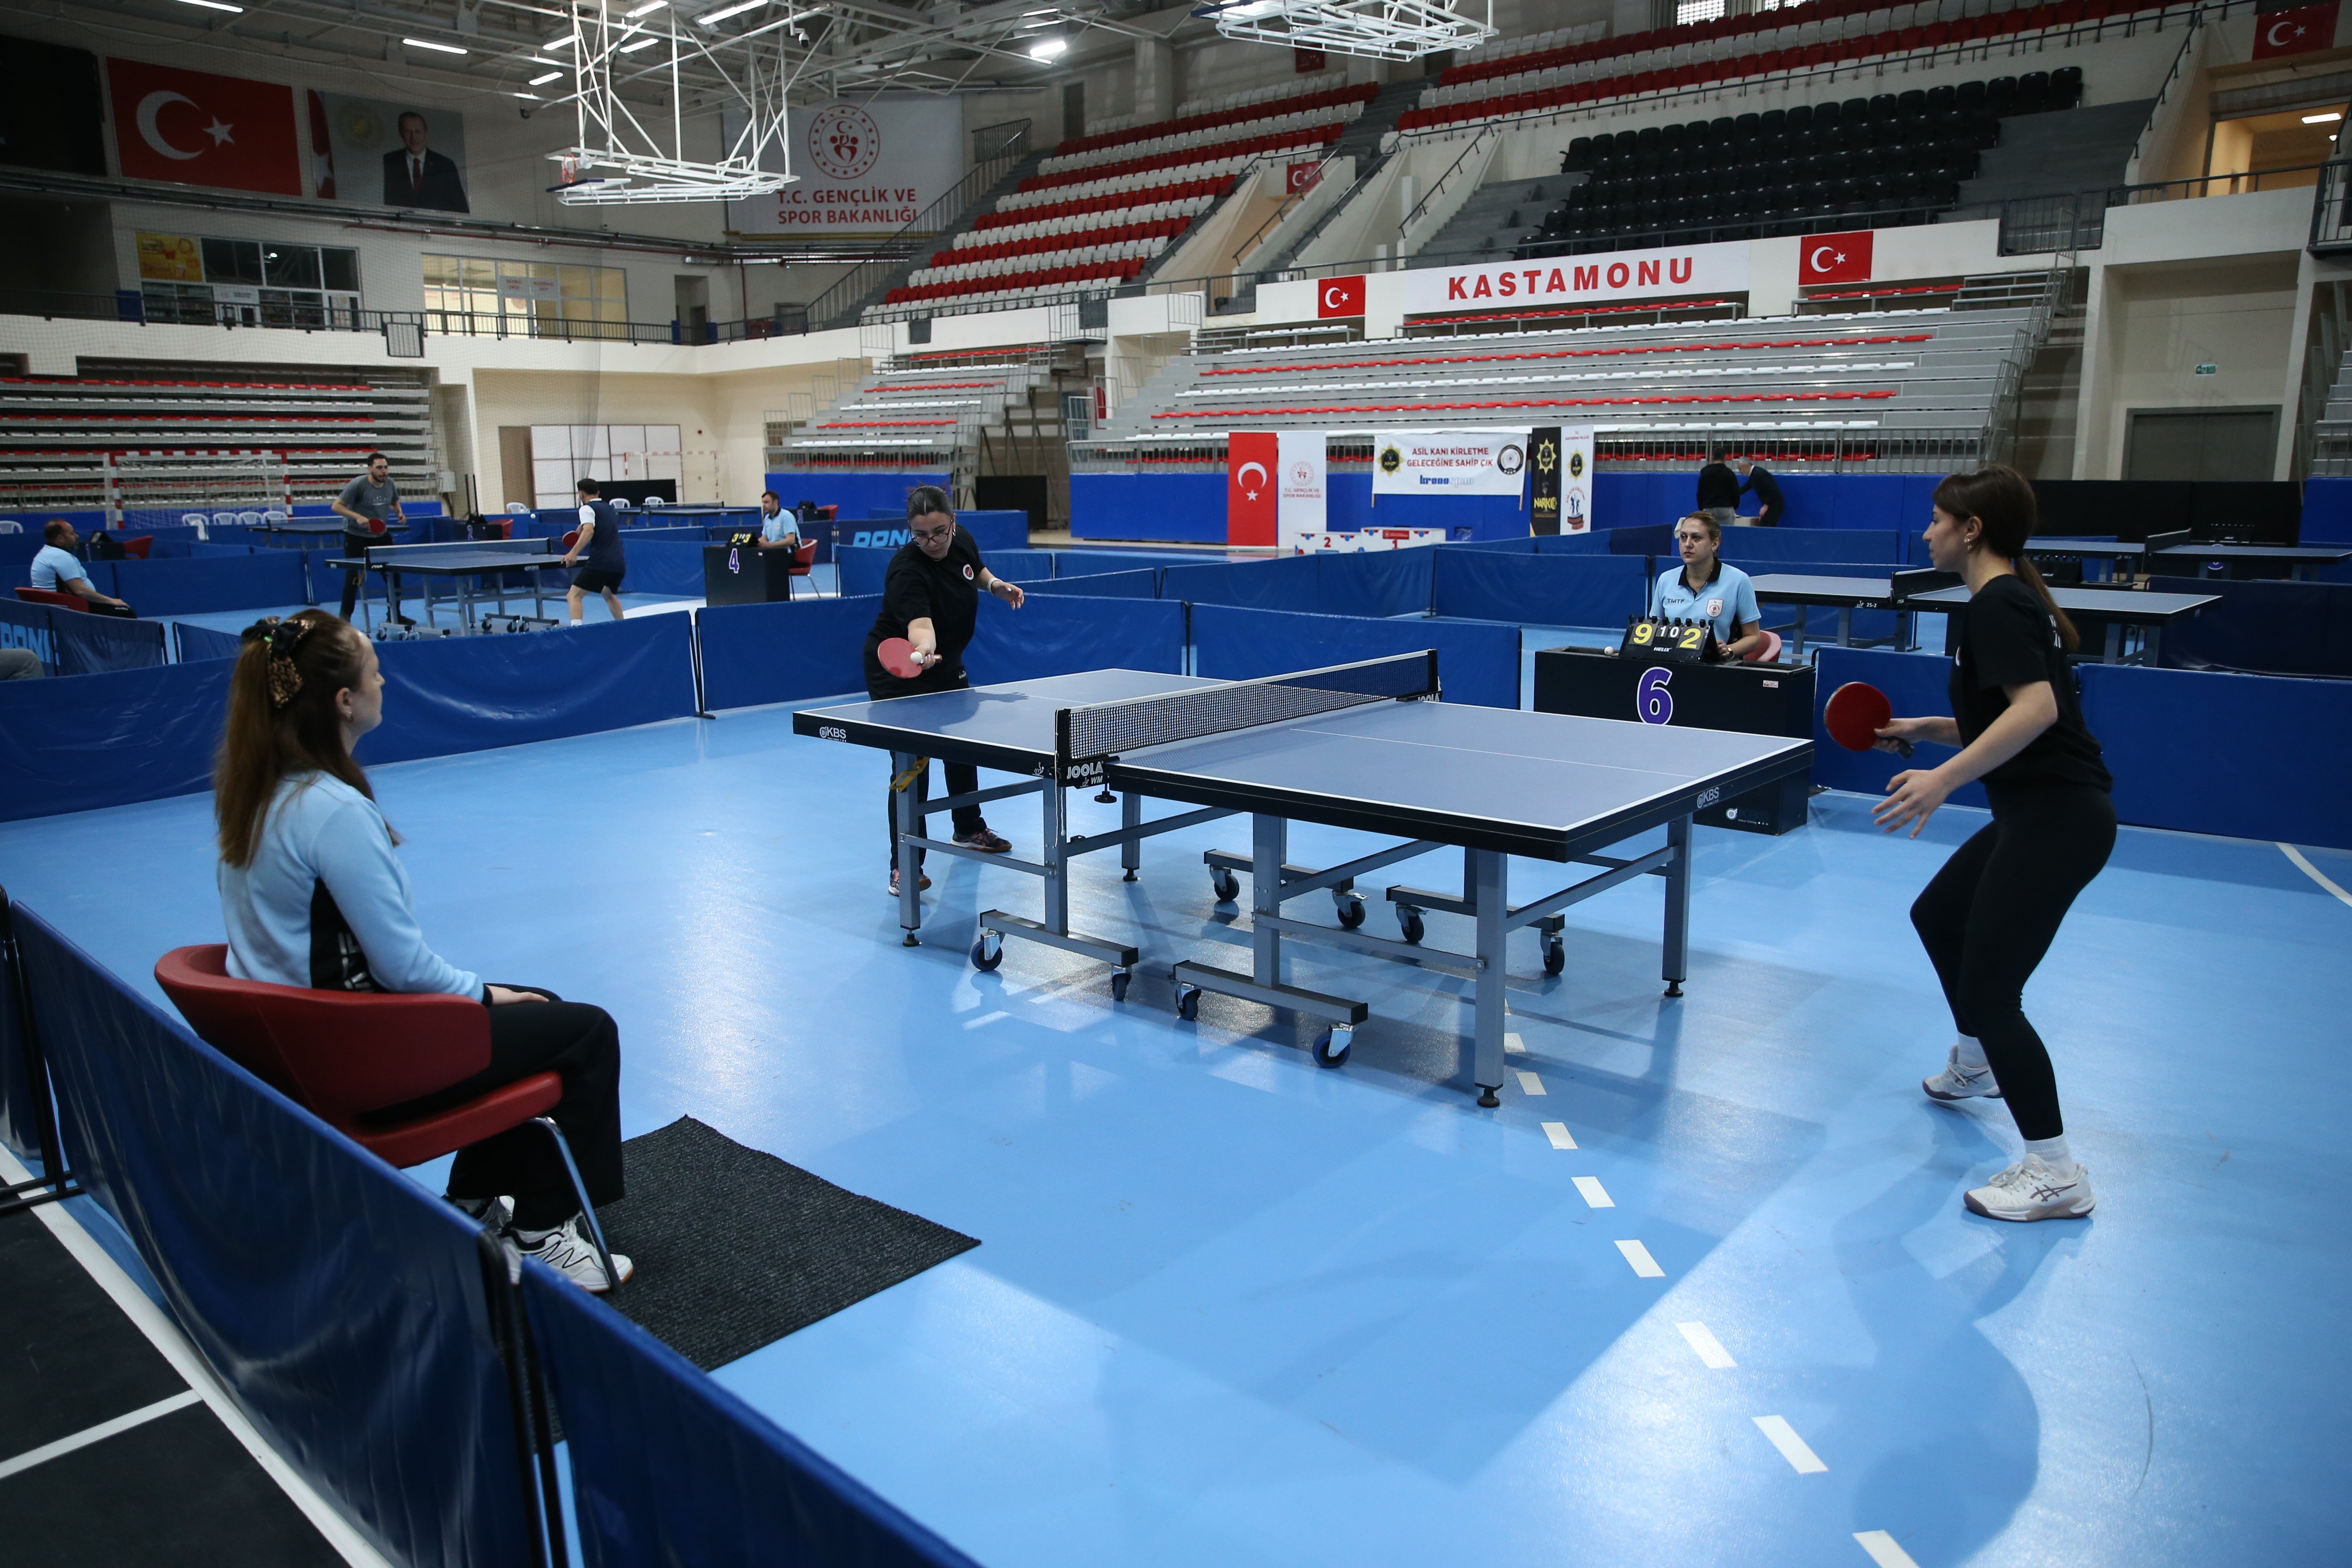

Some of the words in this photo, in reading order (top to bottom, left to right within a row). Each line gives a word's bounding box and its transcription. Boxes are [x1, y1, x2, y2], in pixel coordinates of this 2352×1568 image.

[777, 190, 807, 204] T.C.
[813, 186, 888, 206] GENÇLİK
[895, 189, 916, 202] VE
[778, 210, 822, 224] SPOR
[827, 206, 916, 223] BAKANLIĞI
[1448, 257, 1692, 300] KASTAMONU
[1412, 447, 1428, 455] ASİL
[1451, 446, 1489, 455] KİRLETME
[1407, 458, 1453, 466] GELECEĞİNE
[1324, 537, 1331, 547] 2
[1392, 539, 1397, 549] 1
[729, 548, 740, 573] 4
[1633, 623, 1653, 644] 9
[1679, 628, 1701, 649] 2
[1637, 666, 1673, 725] 6
[827, 726, 847, 739] KBS
[1067, 761, 1103, 779] JOOLA
[1091, 775, 1103, 784] WM
[1703, 787, 1720, 803] KBS
